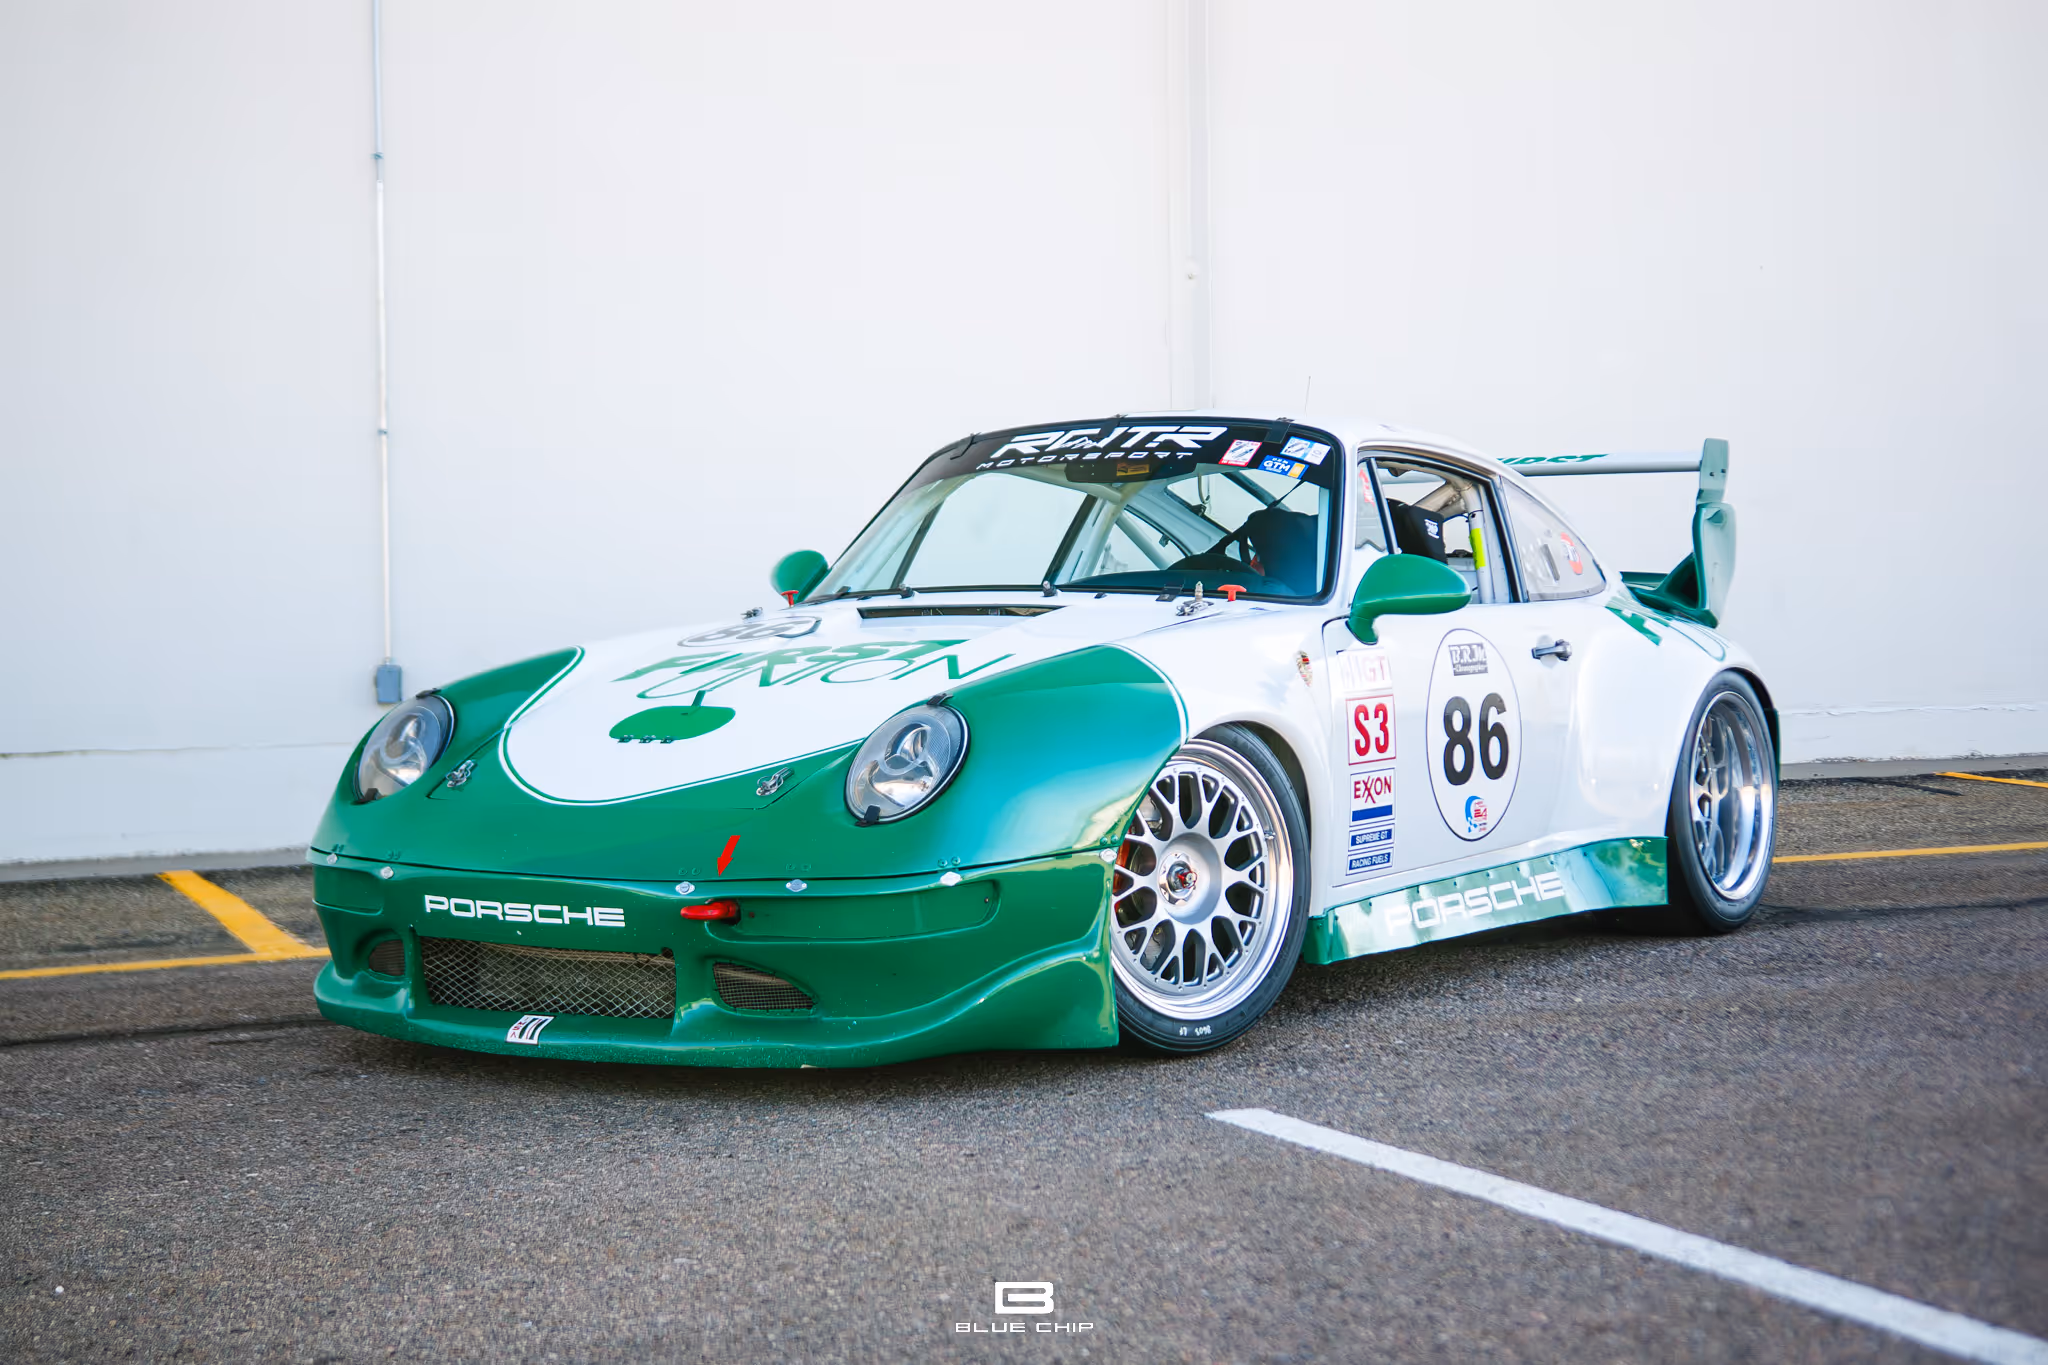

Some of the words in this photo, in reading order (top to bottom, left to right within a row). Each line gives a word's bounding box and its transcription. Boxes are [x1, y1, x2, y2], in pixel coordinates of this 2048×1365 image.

[976, 451, 1193, 470] MOTORSPORT
[1263, 460, 1290, 472] GTM
[688, 620, 812, 643] 86
[611, 639, 971, 682] FIRST
[637, 653, 1016, 699] UNION
[1354, 703, 1389, 756] S3
[1443, 692, 1509, 787] 86
[1354, 776, 1392, 804] EXXON
[1355, 831, 1380, 845] SUPREME
[1380, 830, 1389, 840] GT
[1351, 857, 1372, 869] RACING
[1372, 853, 1389, 865] FUELS
[424, 894, 626, 927] PORSCHE
[1384, 871, 1565, 937] PORSCHE
